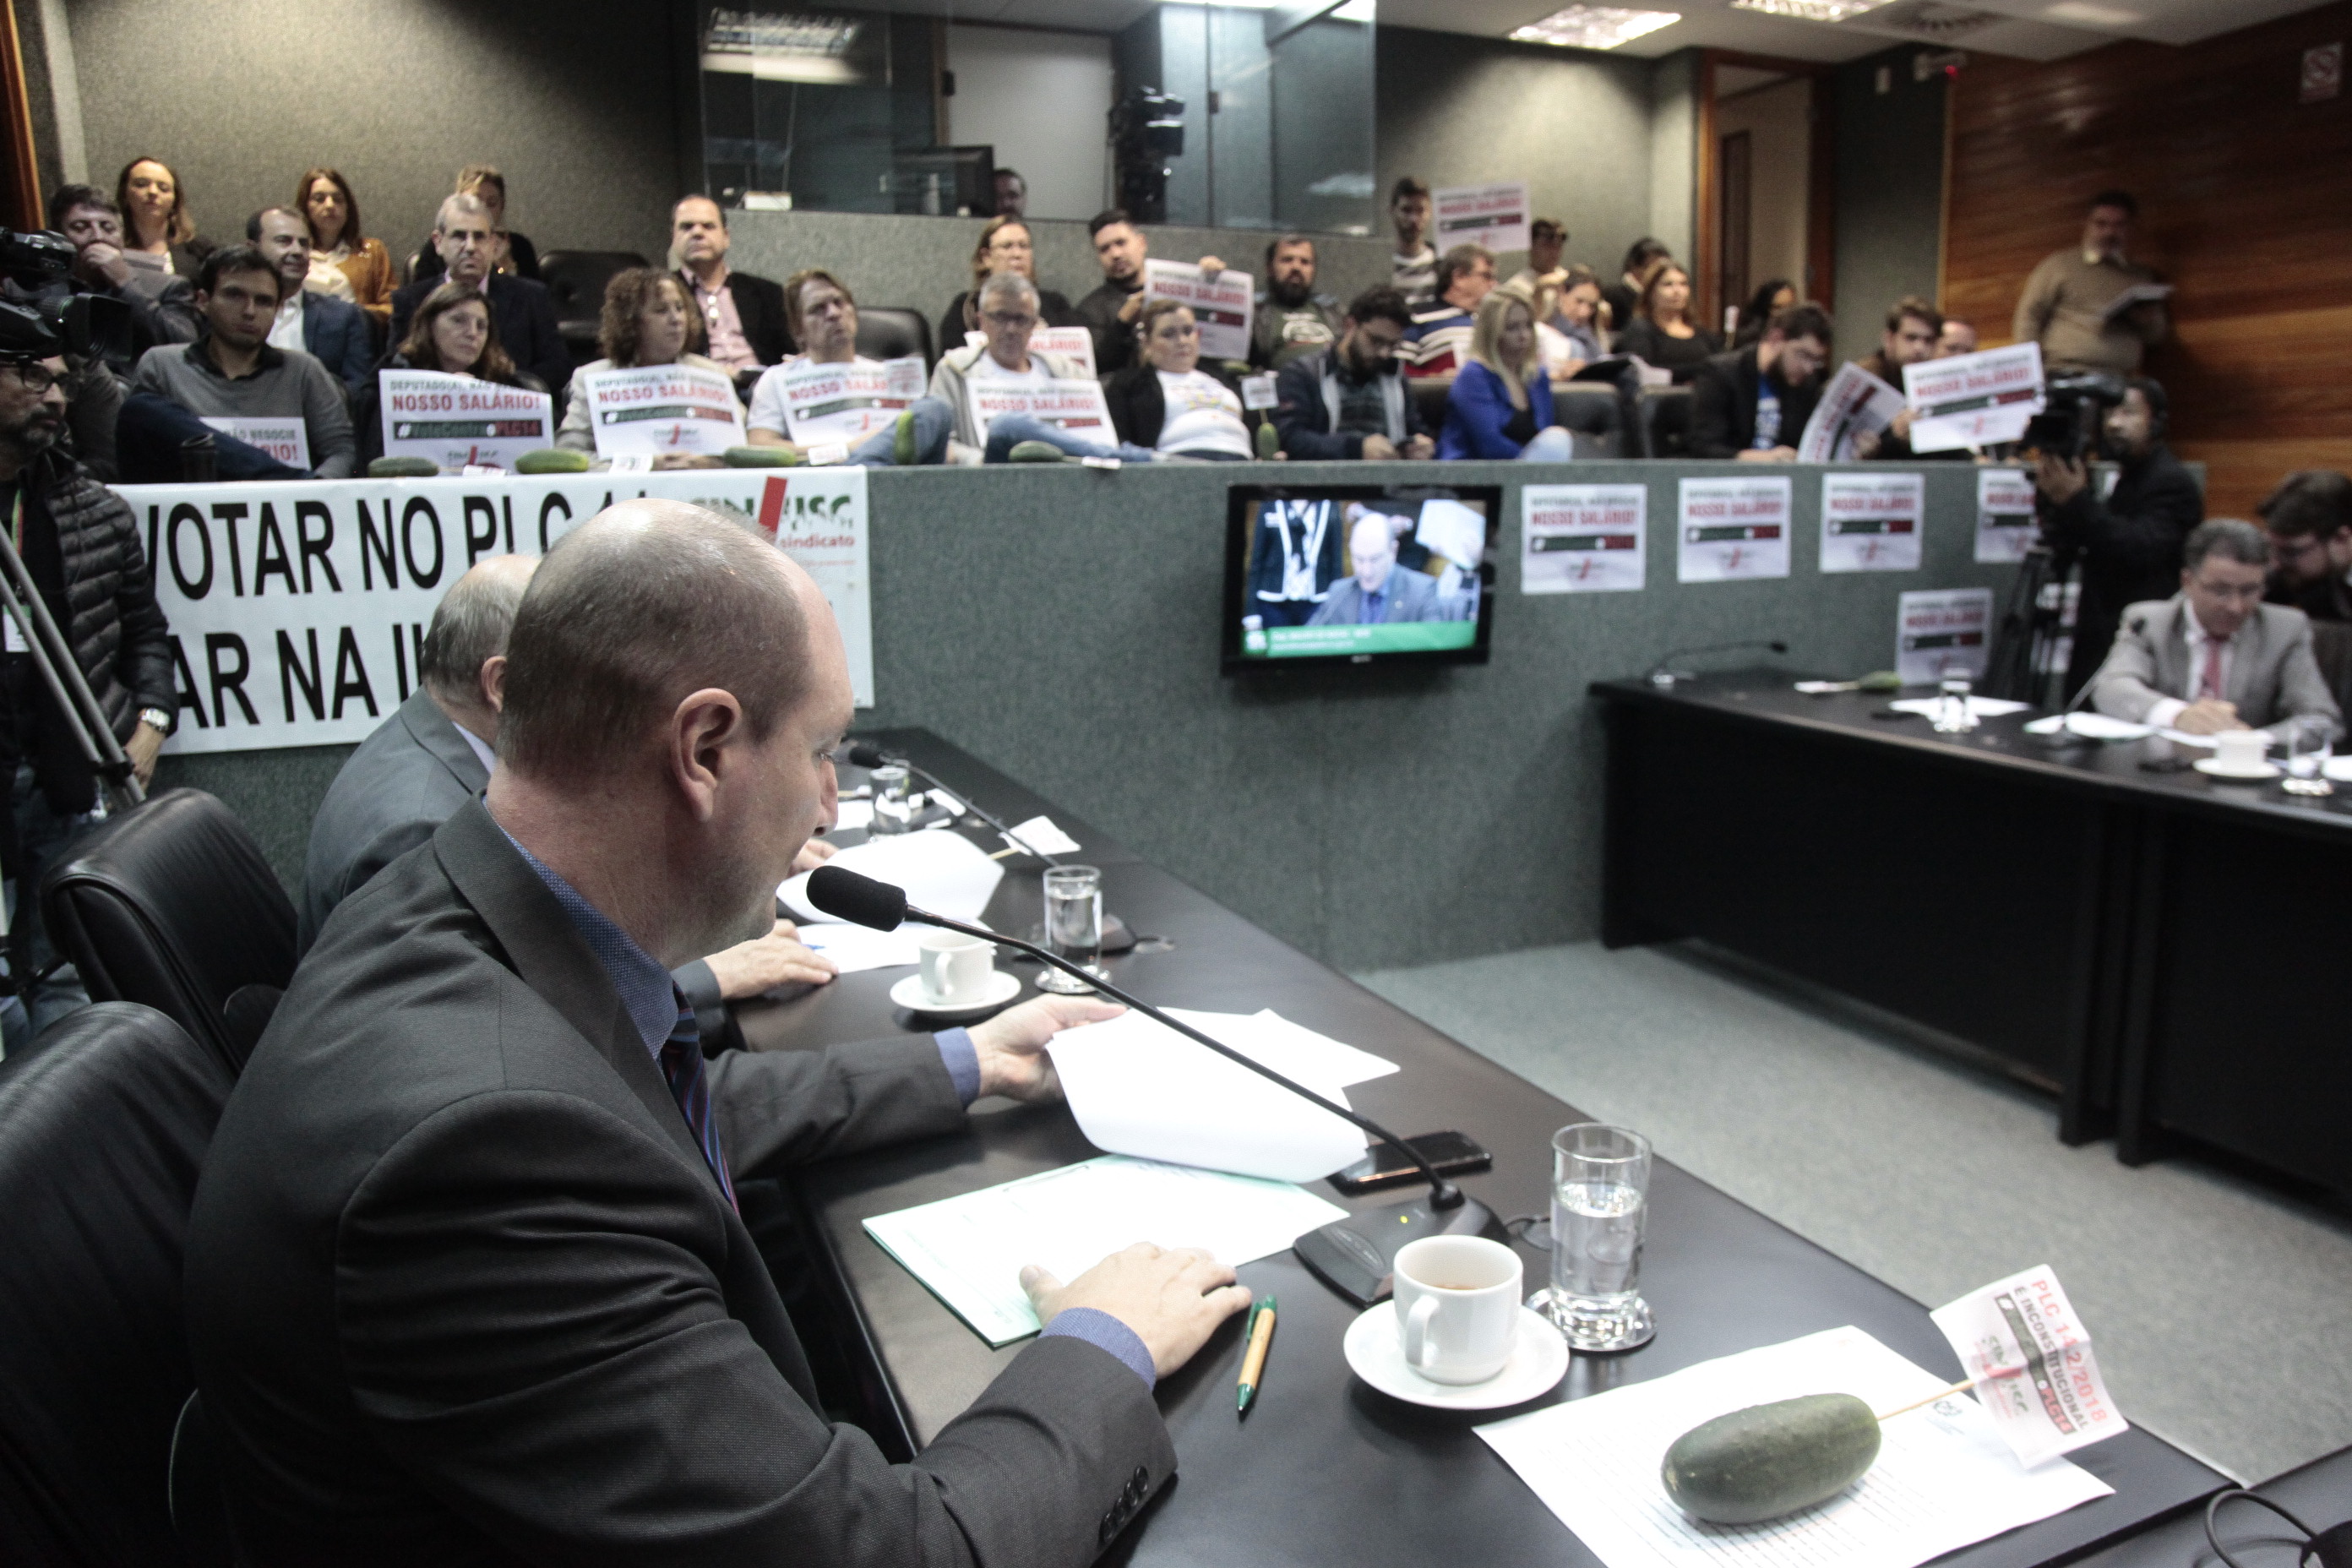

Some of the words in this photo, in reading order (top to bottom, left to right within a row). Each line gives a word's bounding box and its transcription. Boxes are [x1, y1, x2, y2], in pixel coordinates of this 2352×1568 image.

[393, 394, 452, 411] NOSSO
[460, 391, 541, 410] SALÁRIO!
[598, 386, 653, 403] NOSSO
[357, 496, 444, 591] NO
[781, 533, 855, 548] sindicato
[275, 626, 379, 722] NA
[2031, 1279, 2061, 1318] PLC
[2020, 1298, 2089, 1430] INCONSTITUCIONAL
